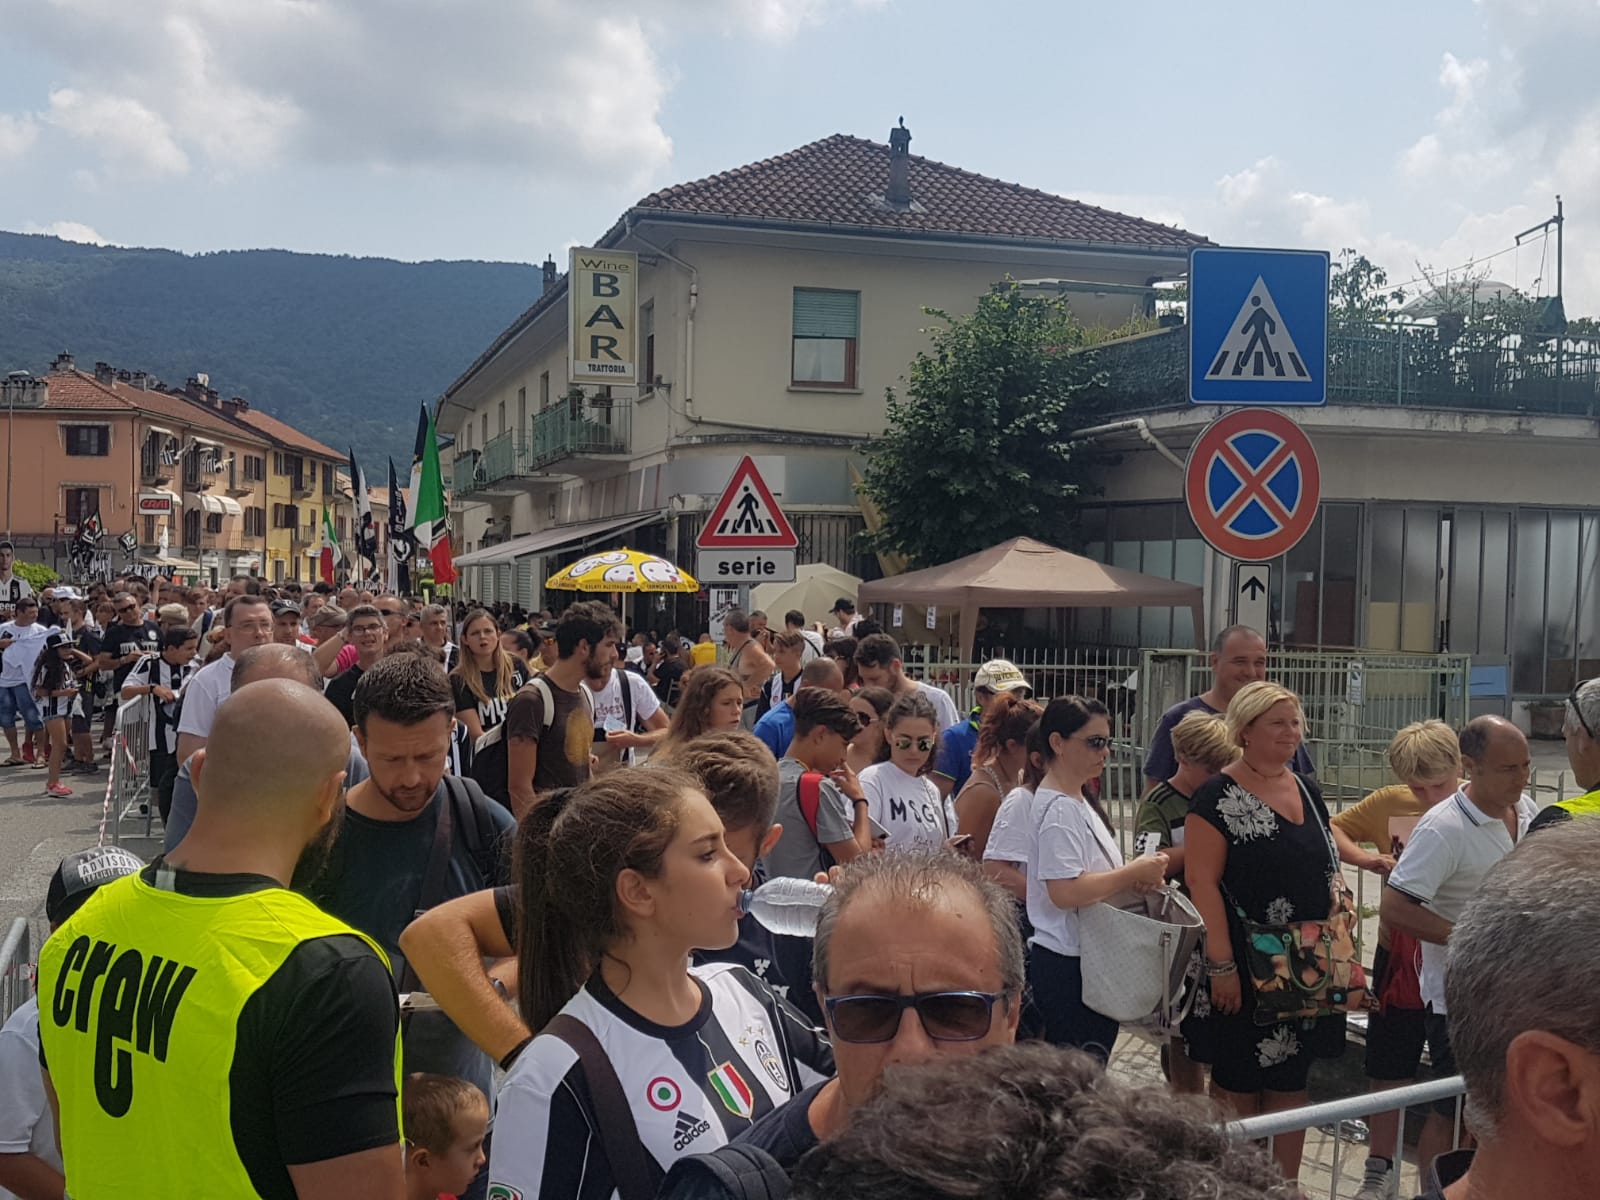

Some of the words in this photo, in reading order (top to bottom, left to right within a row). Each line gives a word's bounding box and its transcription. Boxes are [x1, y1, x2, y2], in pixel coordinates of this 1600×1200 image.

[580, 258, 629, 271] Wine
[584, 272, 625, 361] BAR
[588, 363, 626, 374] TRATTORIA
[718, 555, 776, 576] serie
[889, 797, 937, 828] MSG
[53, 935, 198, 1118] crew
[674, 1120, 711, 1151] adidas
